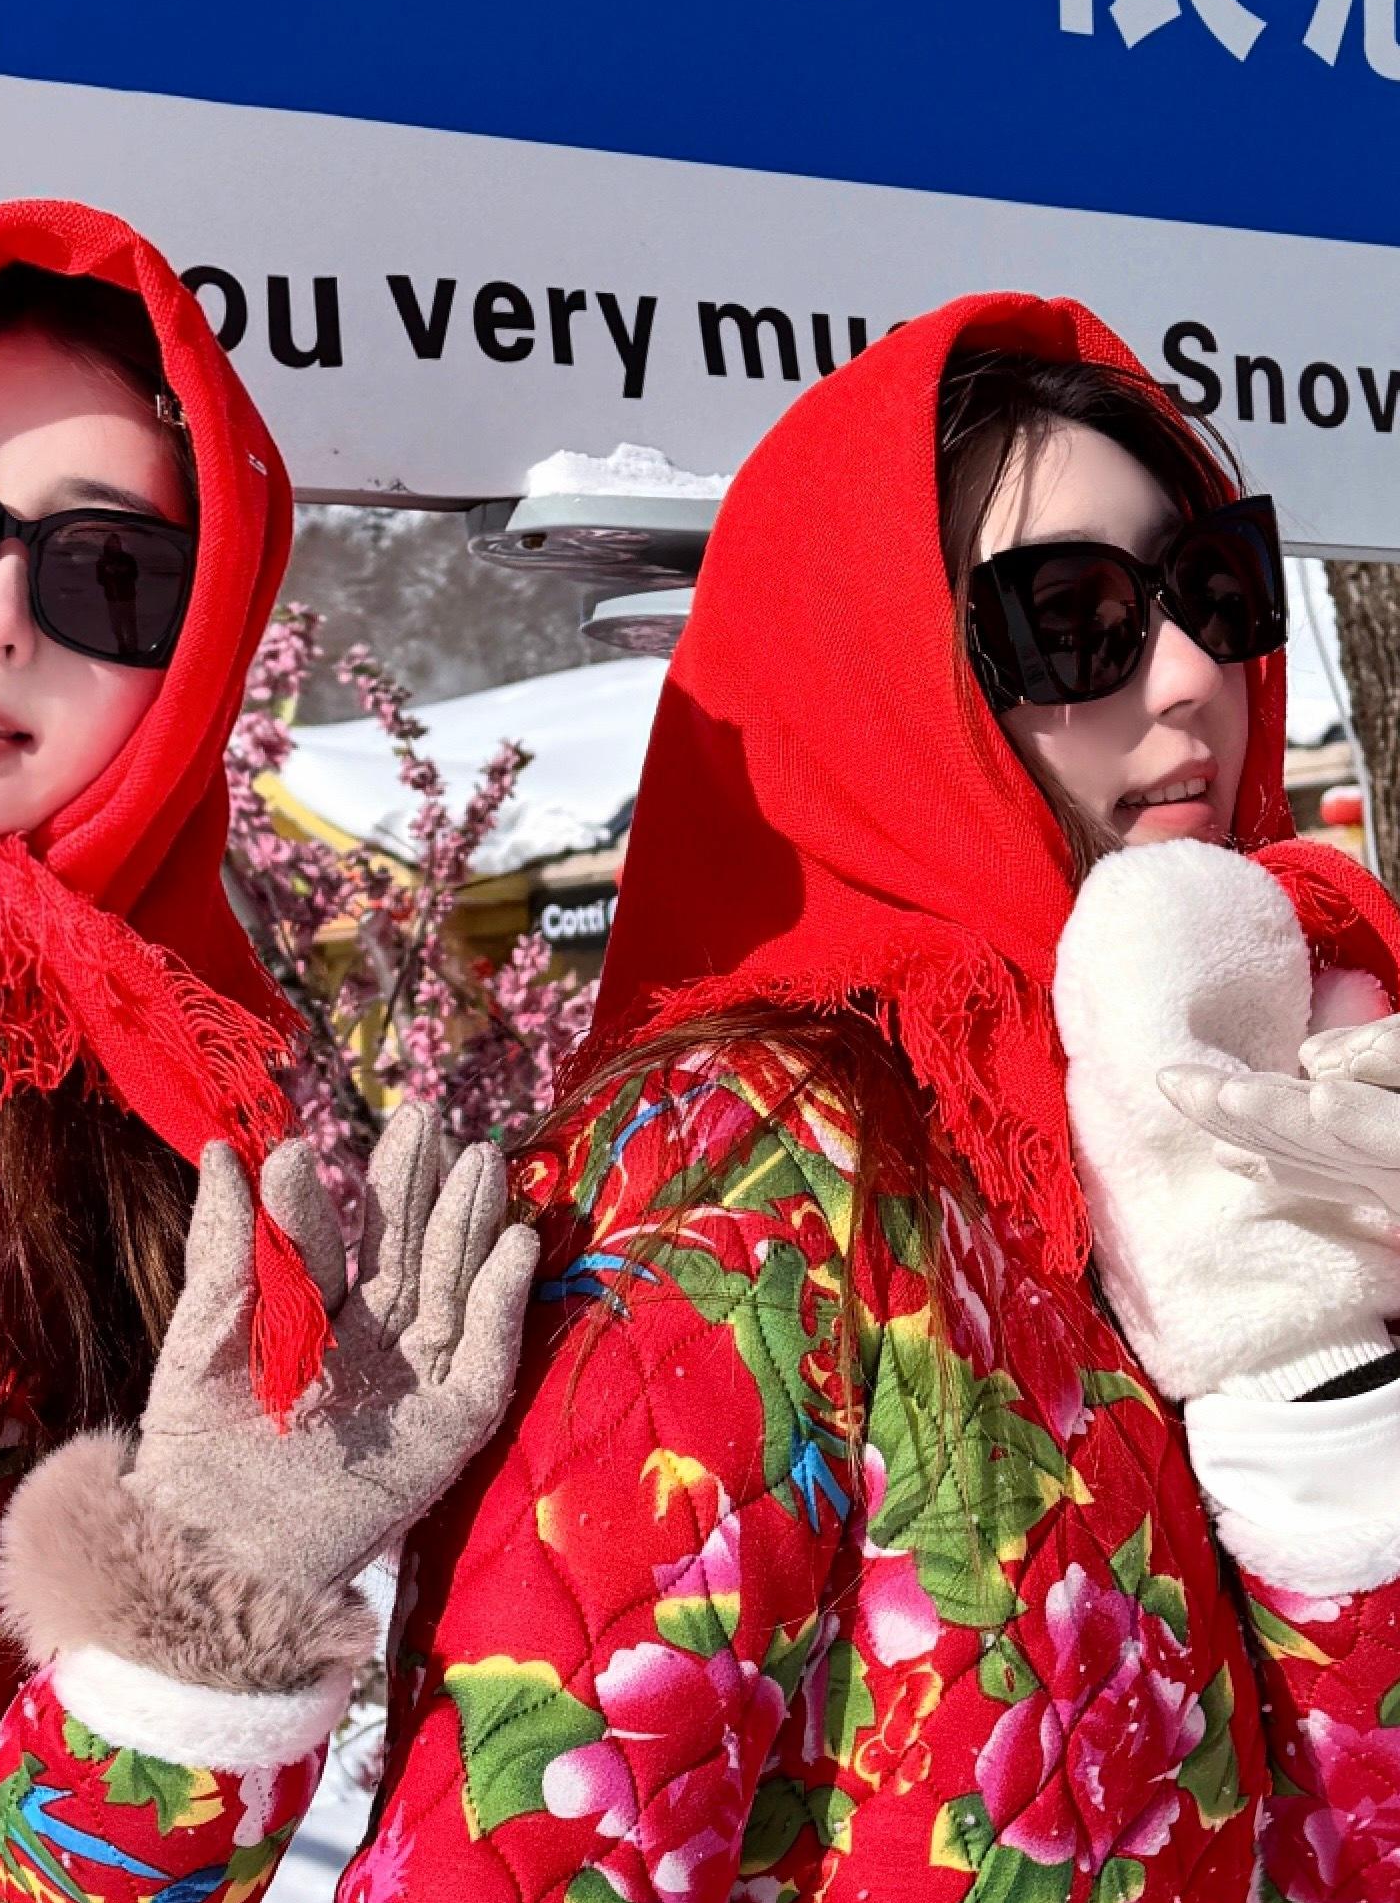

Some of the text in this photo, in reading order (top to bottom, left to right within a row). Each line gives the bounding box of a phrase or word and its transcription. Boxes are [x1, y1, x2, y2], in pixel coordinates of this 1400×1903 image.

[179, 264, 344, 370] ou
[385, 273, 658, 399] very
[697, 300, 910, 383] mu
